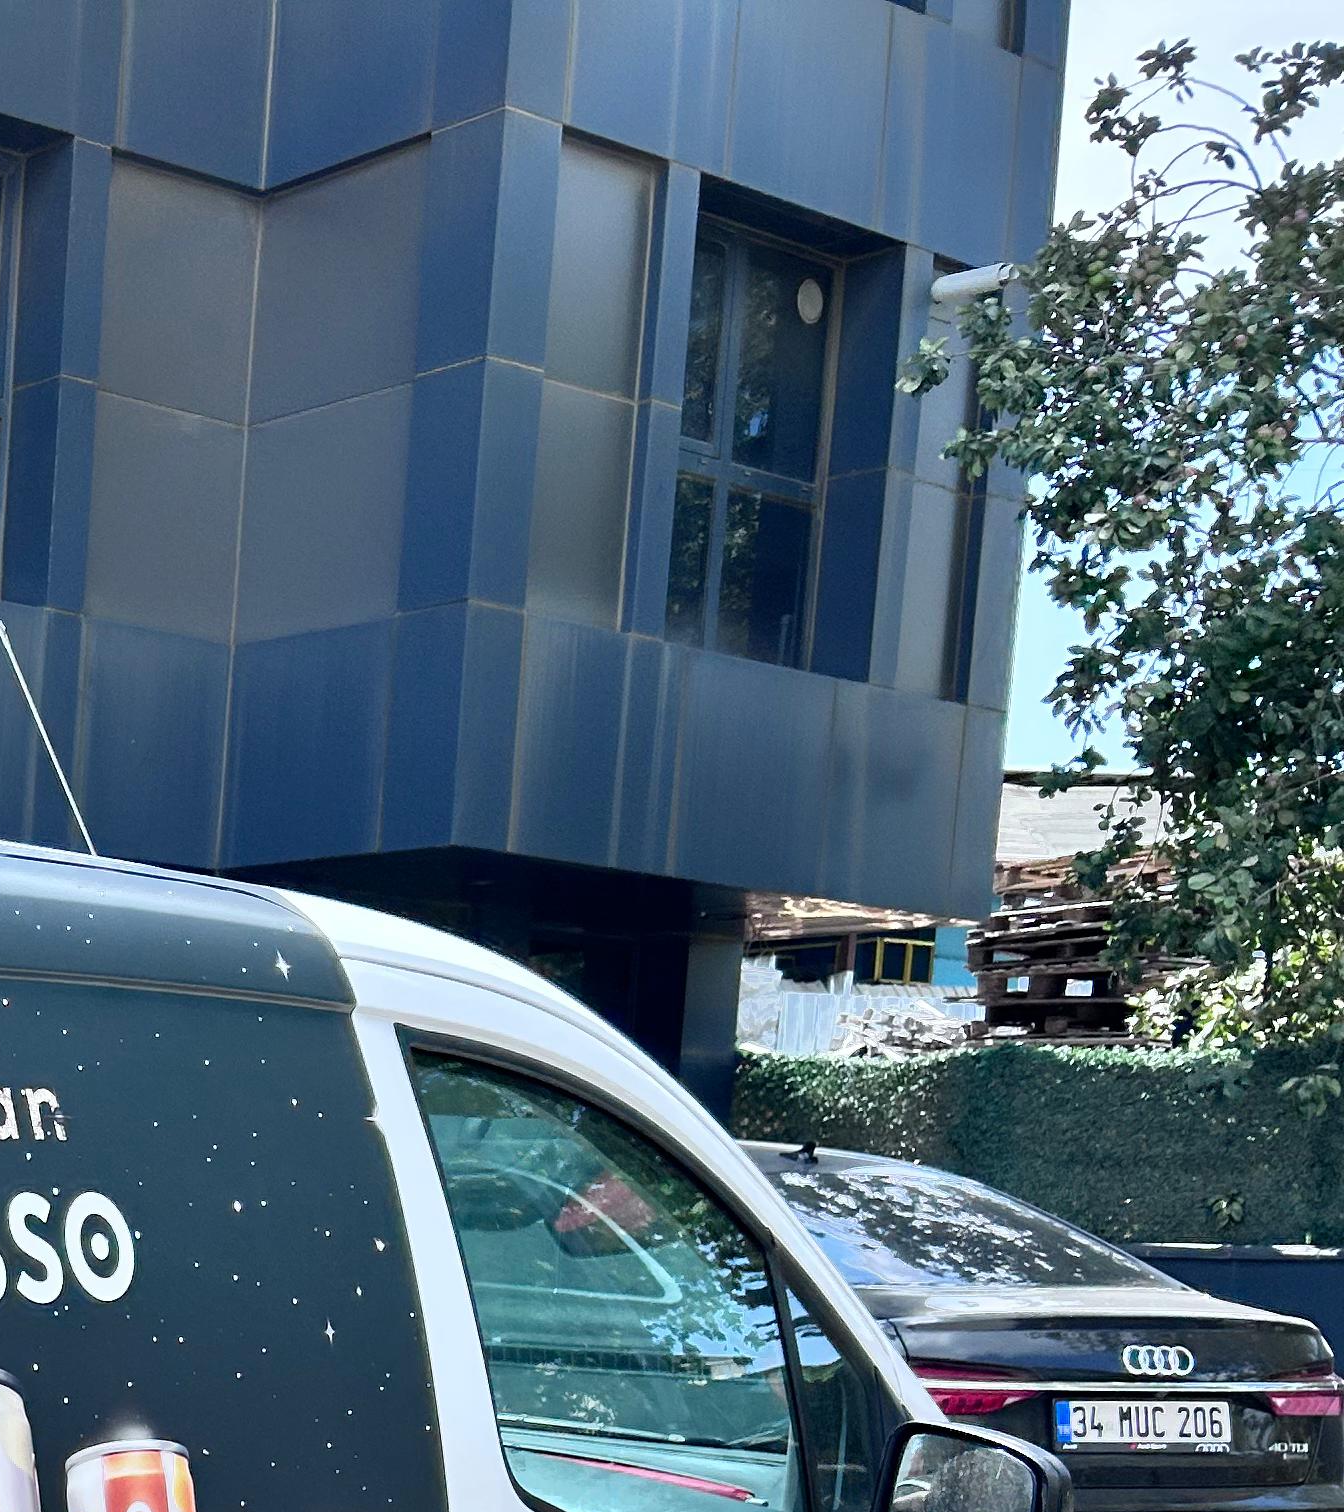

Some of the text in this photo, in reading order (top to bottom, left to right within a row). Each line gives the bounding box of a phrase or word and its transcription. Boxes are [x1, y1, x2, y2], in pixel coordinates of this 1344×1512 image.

[1072, 1406, 1224, 1438] 34 MUC 206
